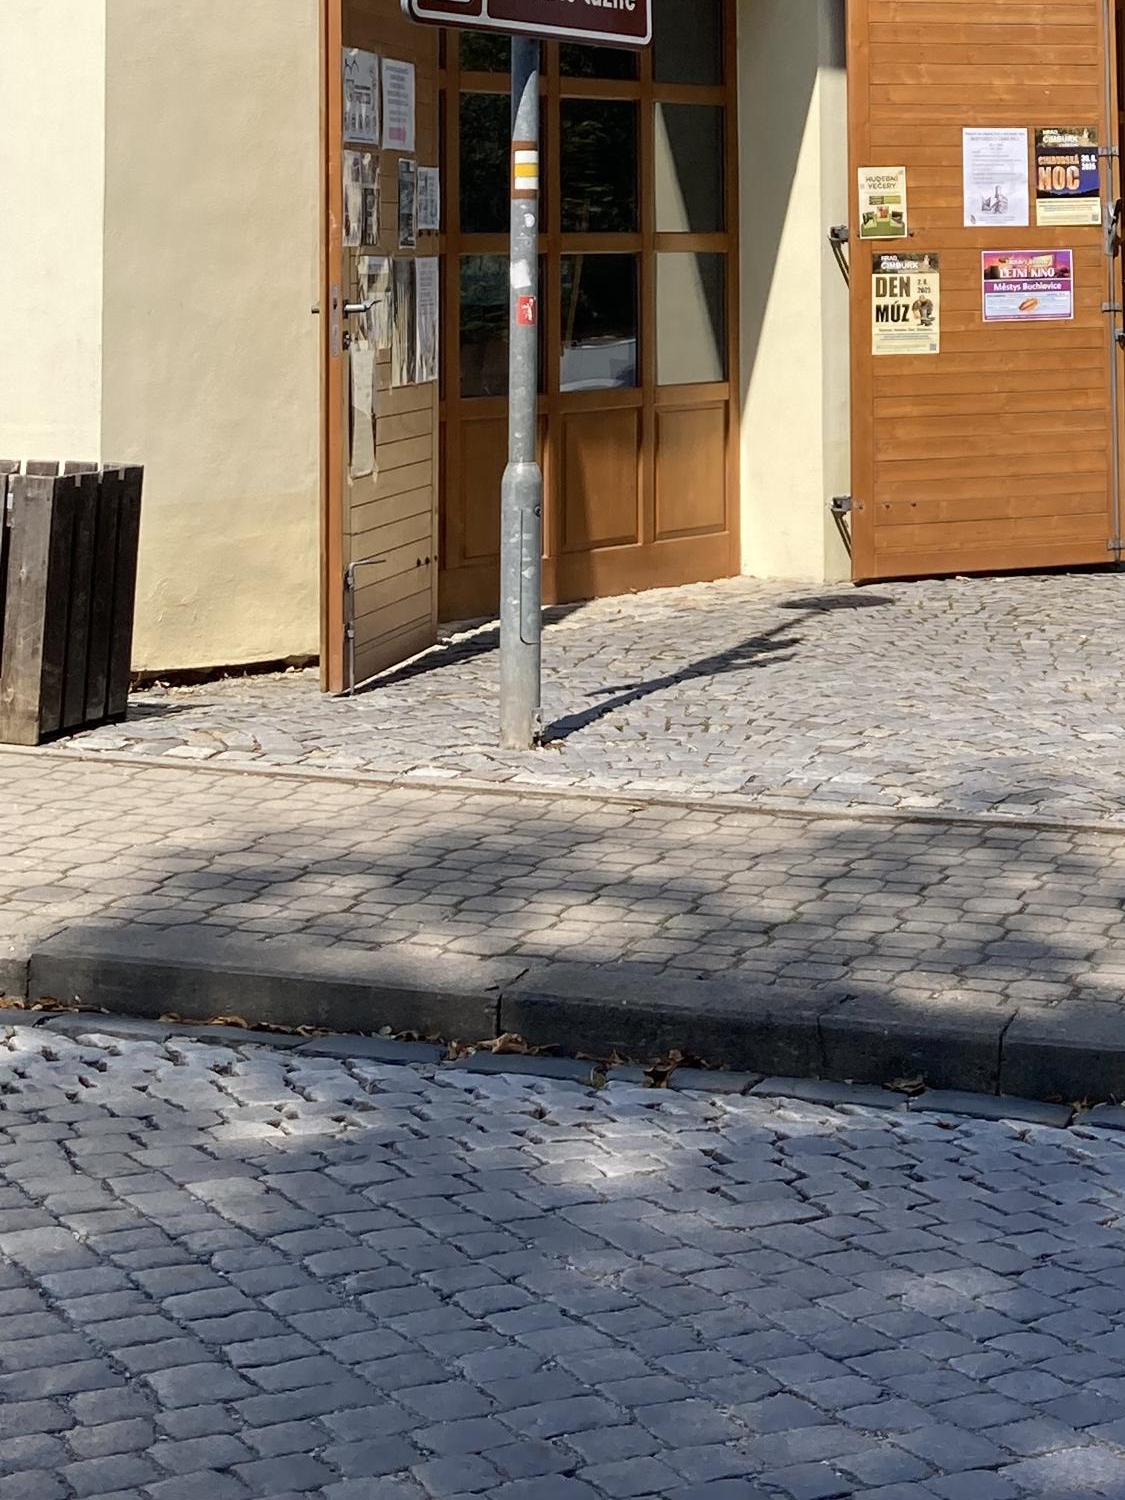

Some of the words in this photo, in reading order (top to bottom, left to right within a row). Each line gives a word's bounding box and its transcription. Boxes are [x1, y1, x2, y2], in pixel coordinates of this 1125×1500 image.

[1038, 166, 1080, 191] NOC
[1030, 267, 1055, 278] KINO
[875, 276, 911, 298] DEN
[993, 282, 1022, 292] Městys
[1022, 281, 1062, 291] Buchlovice
[875, 300, 910, 323] MÚZ
